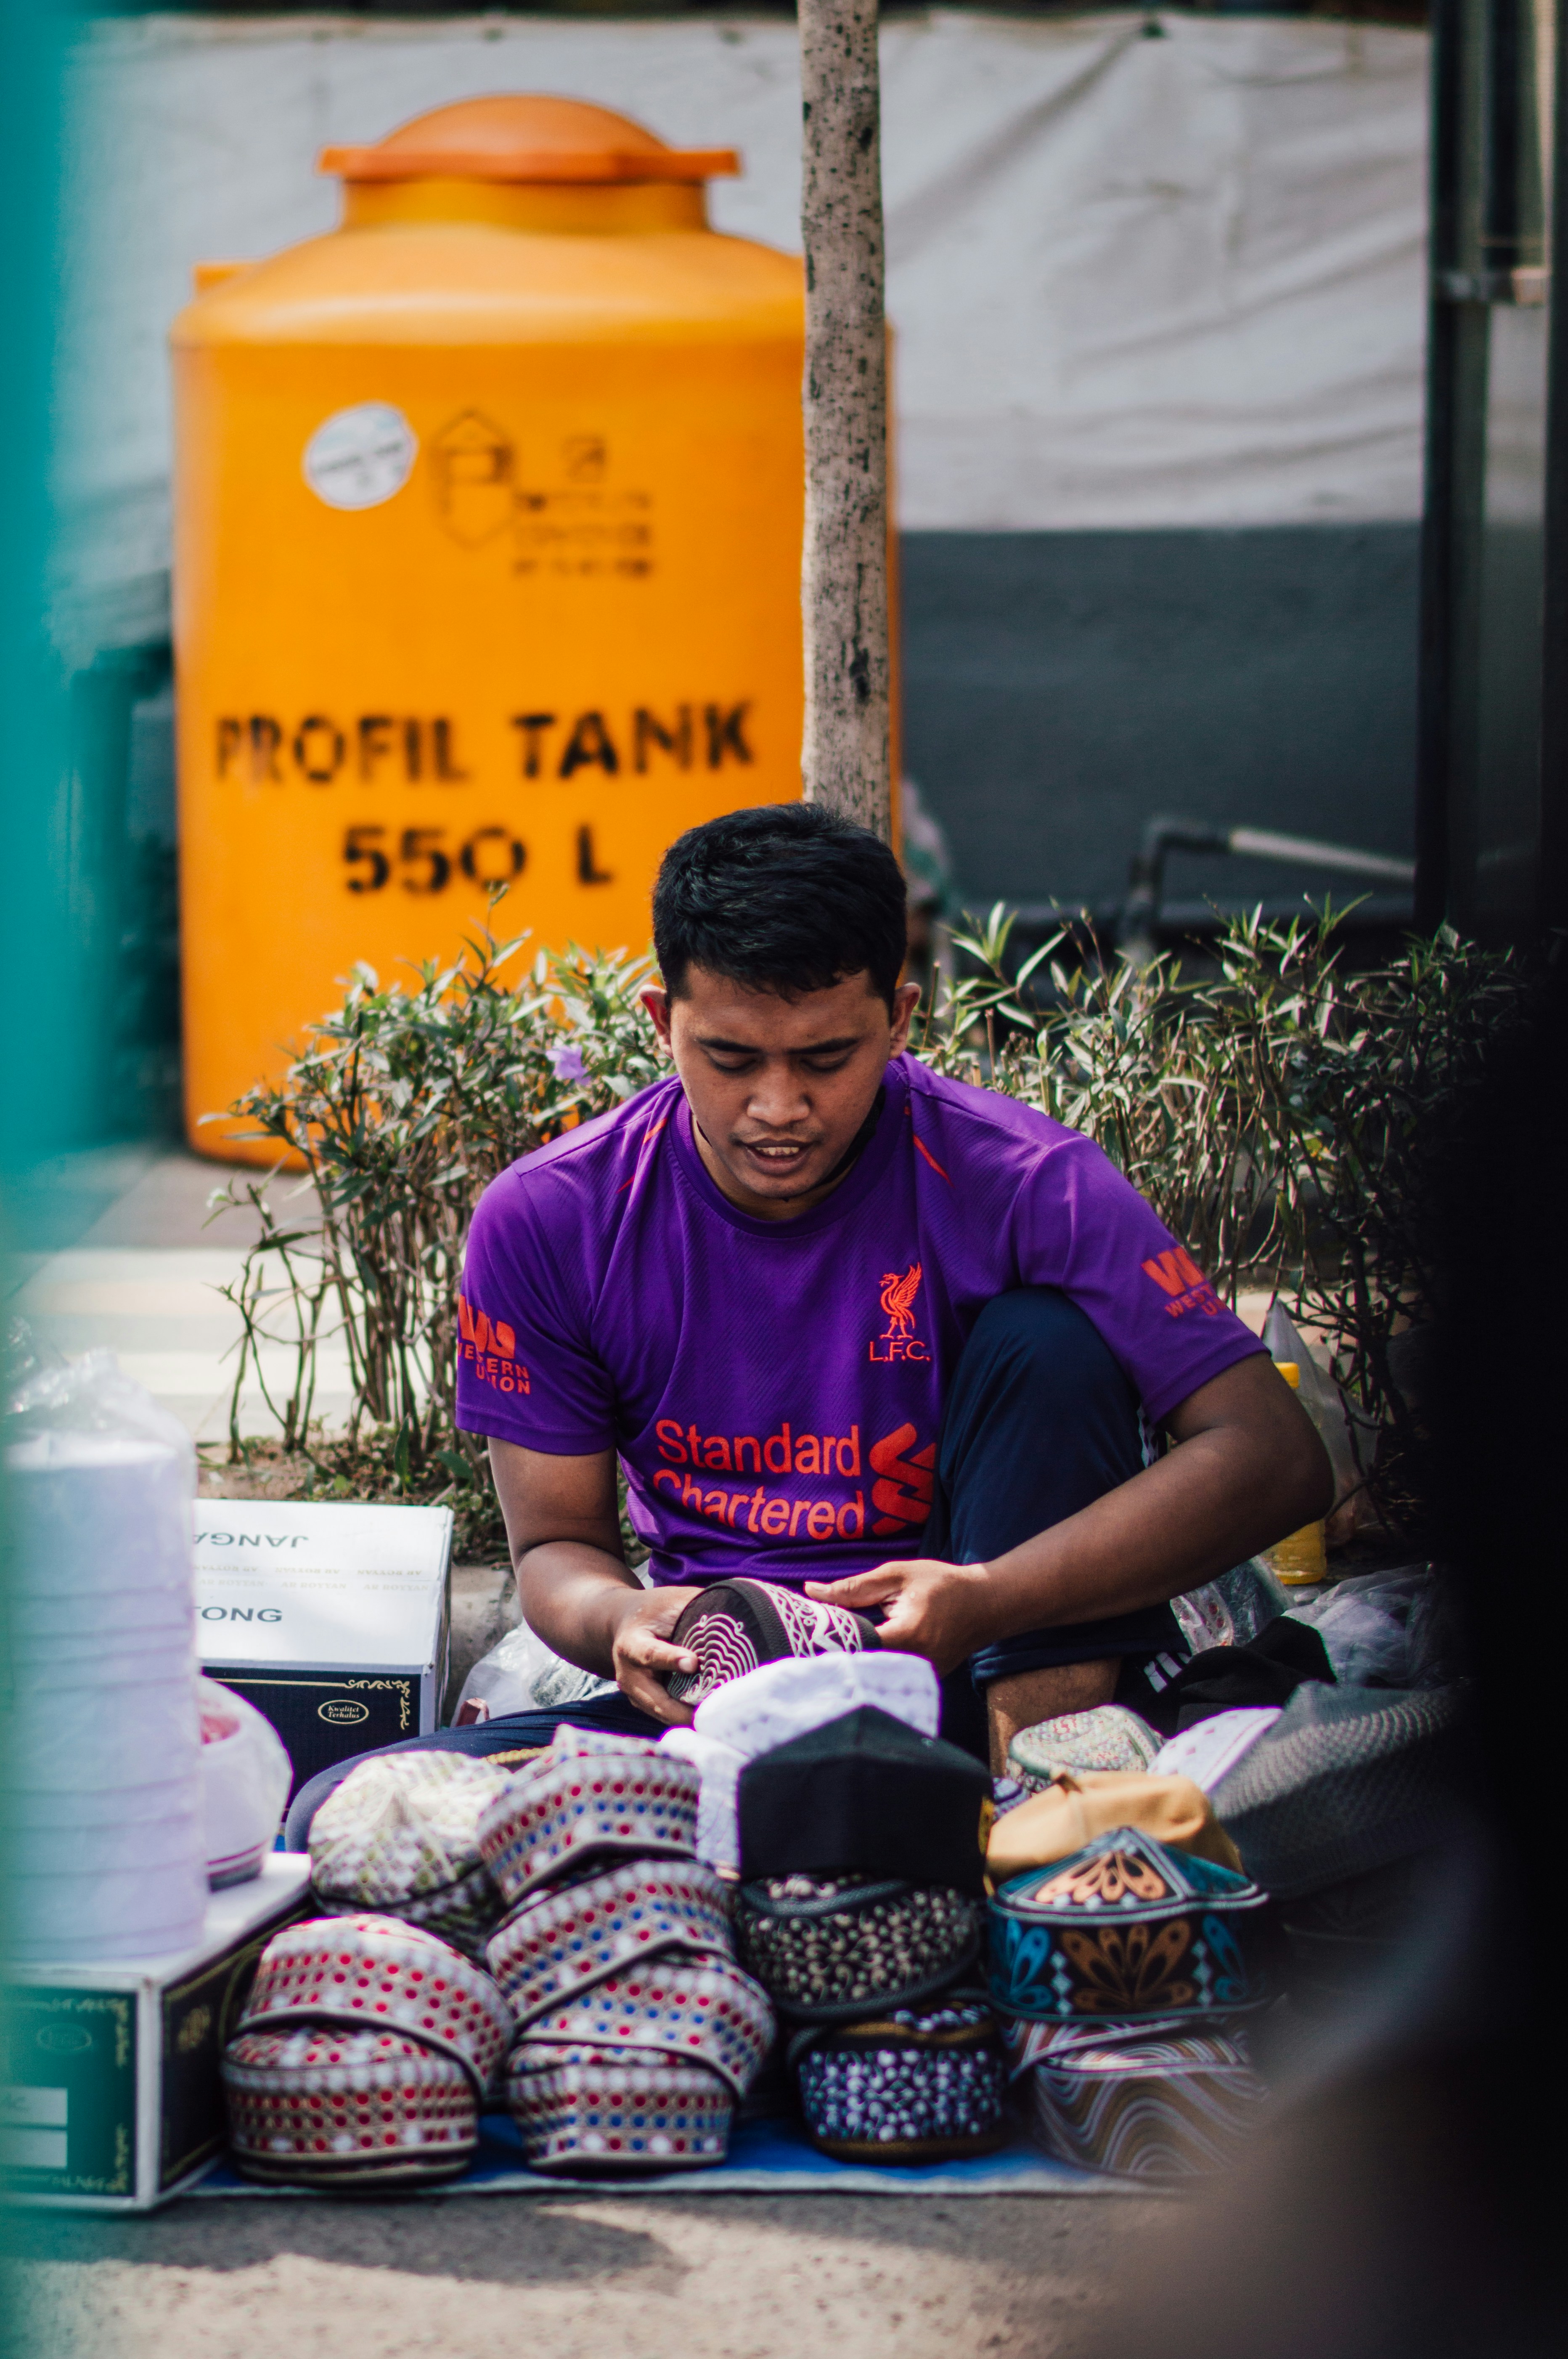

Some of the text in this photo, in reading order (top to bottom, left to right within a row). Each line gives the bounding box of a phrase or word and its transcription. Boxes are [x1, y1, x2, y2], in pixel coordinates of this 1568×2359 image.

[215, 698, 755, 785] PROFIL TANK
[344, 824, 612, 894] 550 L
[475, 1364, 531, 1395] UION
[869, 1340, 931, 1362] L.F.C.
[655, 1419, 861, 1477] Standard
[653, 1468, 865, 1540] Chartered
